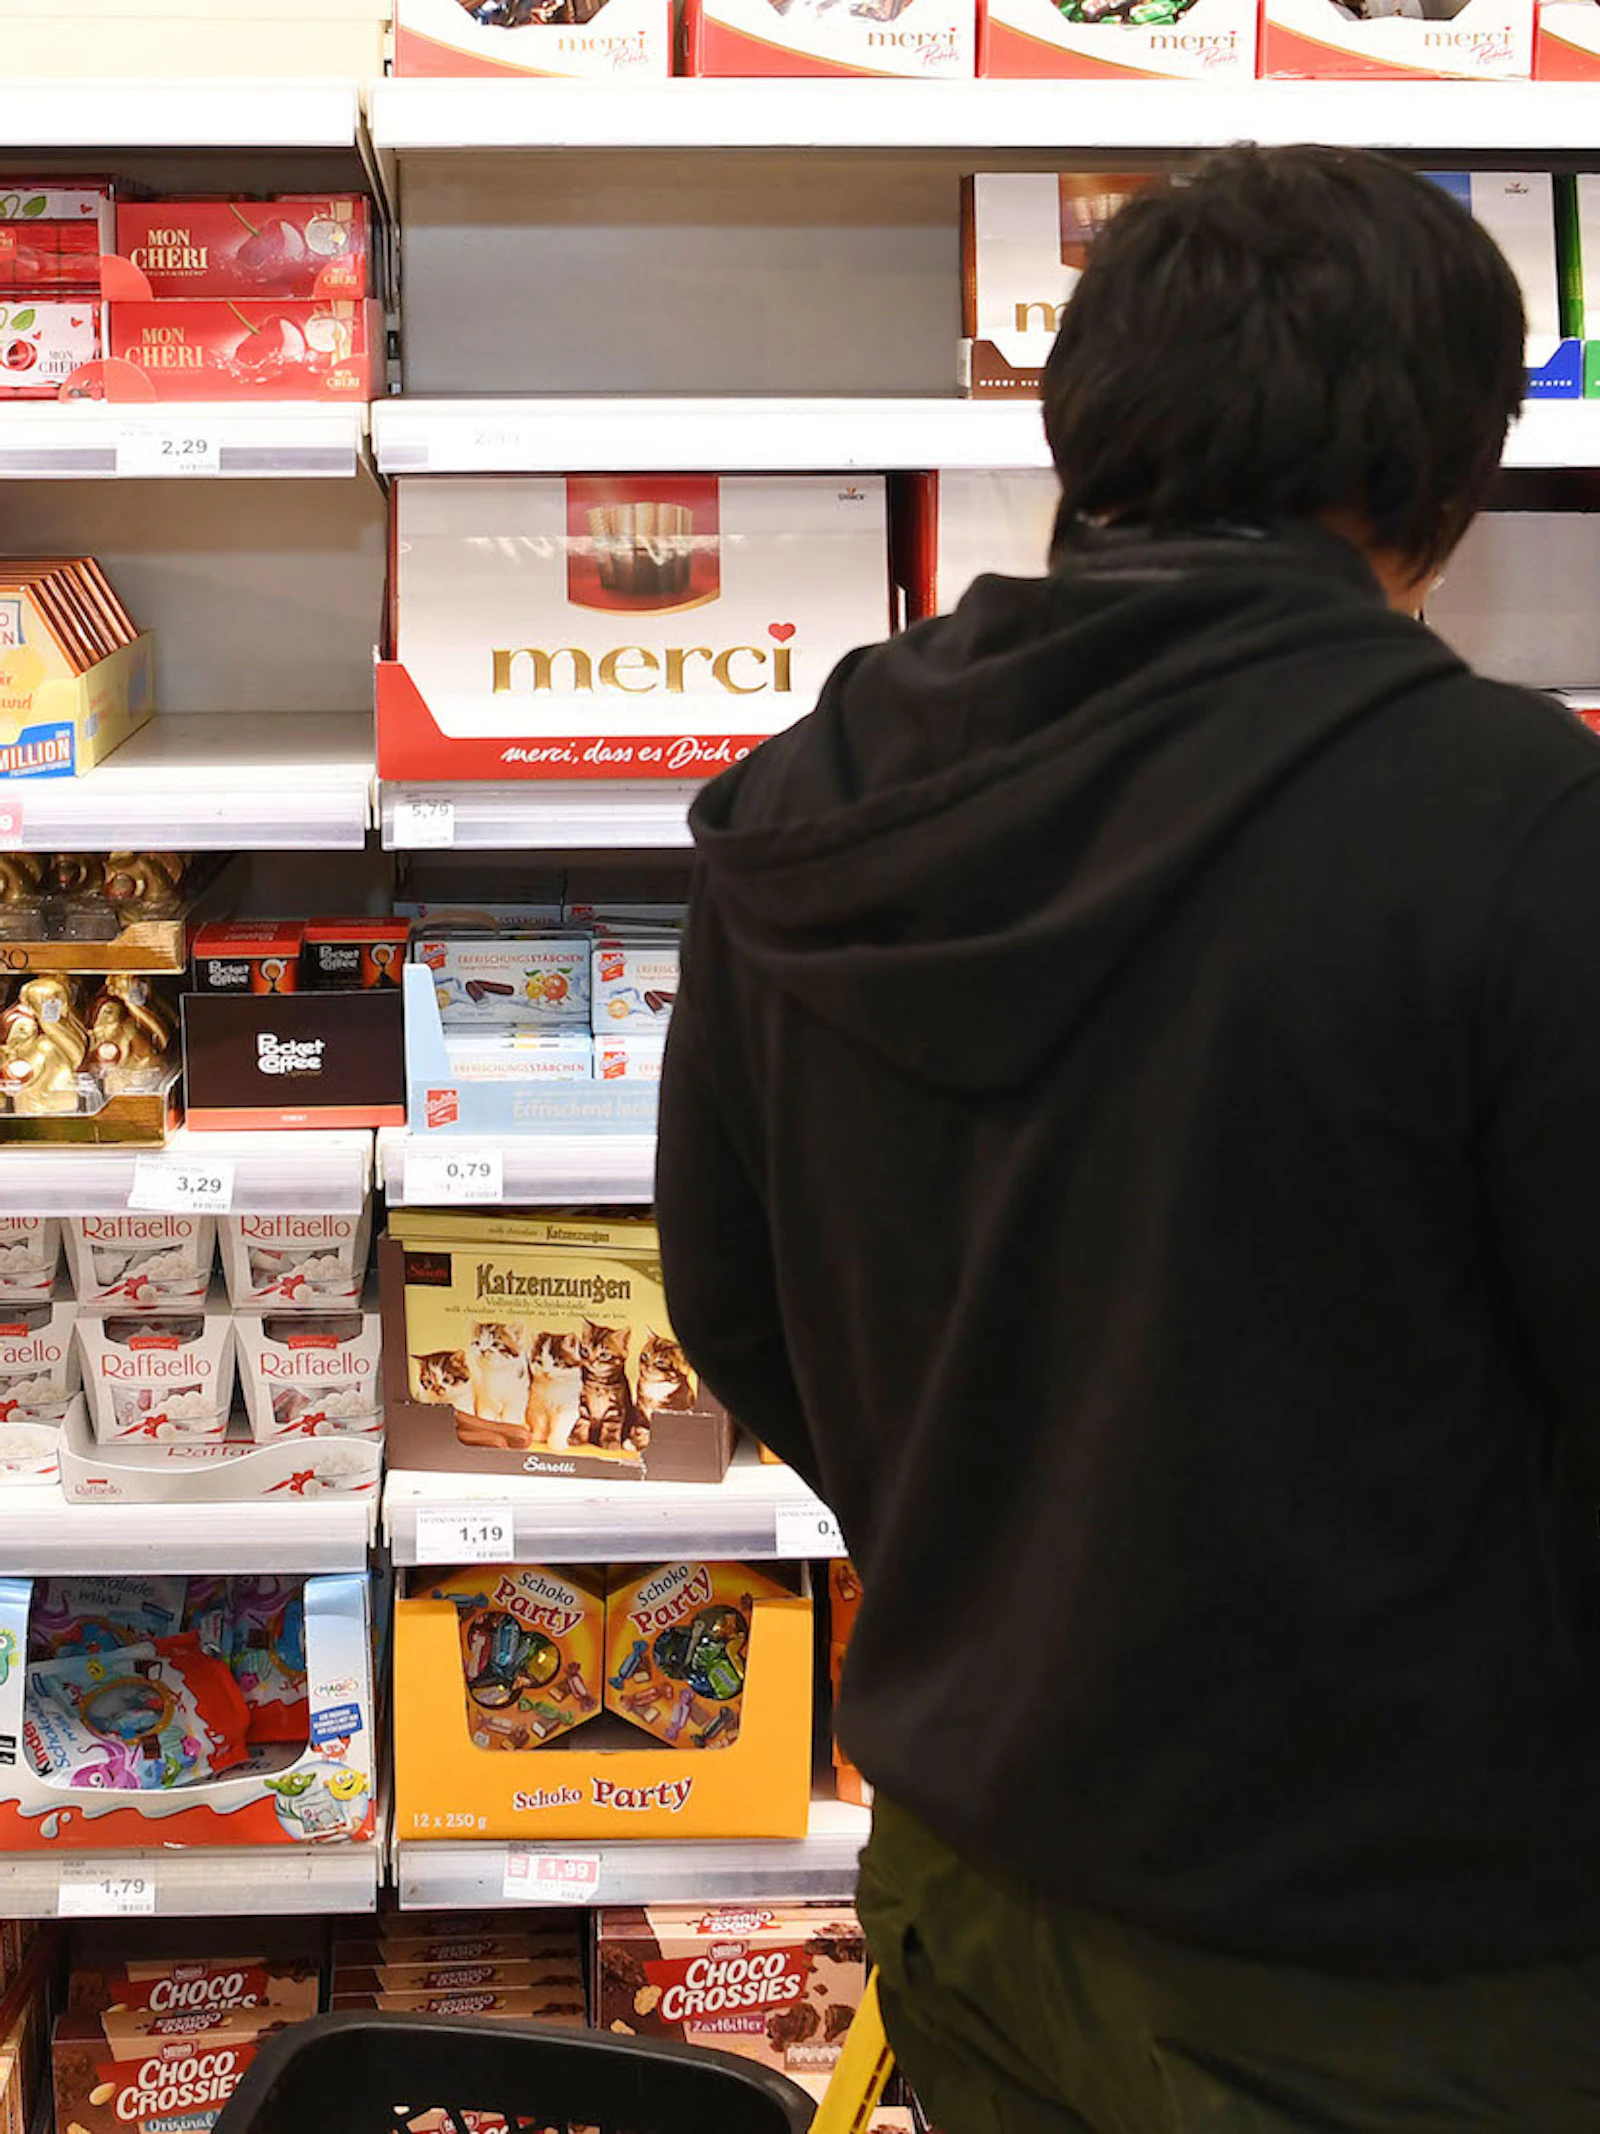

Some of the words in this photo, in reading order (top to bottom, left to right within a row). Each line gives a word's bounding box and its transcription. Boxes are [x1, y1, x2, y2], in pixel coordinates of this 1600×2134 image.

[559, 31, 645, 51] merci
[868, 27, 957, 46] merci
[1151, 30, 1235, 50] merci
[1424, 26, 1511, 46] merci
[148, 229, 190, 246] MON
[142, 328, 184, 345] MON
[161, 439, 207, 456] 2,29
[492, 622, 797, 695] merci
[501, 741, 579, 764] merci,
[583, 739, 633, 764] dass
[638, 747, 663, 763] es
[667, 737, 731, 769] Dich
[412, 802, 448, 819] 5,79
[208, 960, 250, 975] Pocket
[257, 1033, 326, 1057] Pocket
[258, 1054, 323, 1075] Coffee
[447, 1163, 491, 1179] 0,79
[177, 1176, 221, 1194] 3,29
[83, 1216, 192, 1239] Raffaello
[241, 1216, 350, 1239] Raffaello
[476, 1263, 631, 1303] Katzenzungen
[102, 1353, 211, 1378] Raffaello
[260, 1352, 370, 1377] Raffaello
[459, 1526, 503, 1544] 1,19
[818, 1520, 836, 1536] 0,
[519, 1571, 574, 1606] Schoko
[638, 1564, 688, 1607] Schoko
[494, 1577, 583, 1635] Party
[630, 1567, 712, 1633] Party
[515, 1786, 583, 1809] Schoko
[592, 1777, 693, 1812] Party
[413, 1813, 430, 1828] 12
[434, 1817, 442, 1828] x
[446, 1813, 474, 1828] 250
[478, 1816, 487, 1830] g
[100, 1879, 145, 1898] 1,79
[685, 1953, 786, 1990] CHOCO
[150, 1972, 244, 2012] CHOCO
[661, 1974, 802, 2021] CROSSIES
[138, 2051, 236, 2091] CHOCO
[149, 2112, 214, 2133] Original
